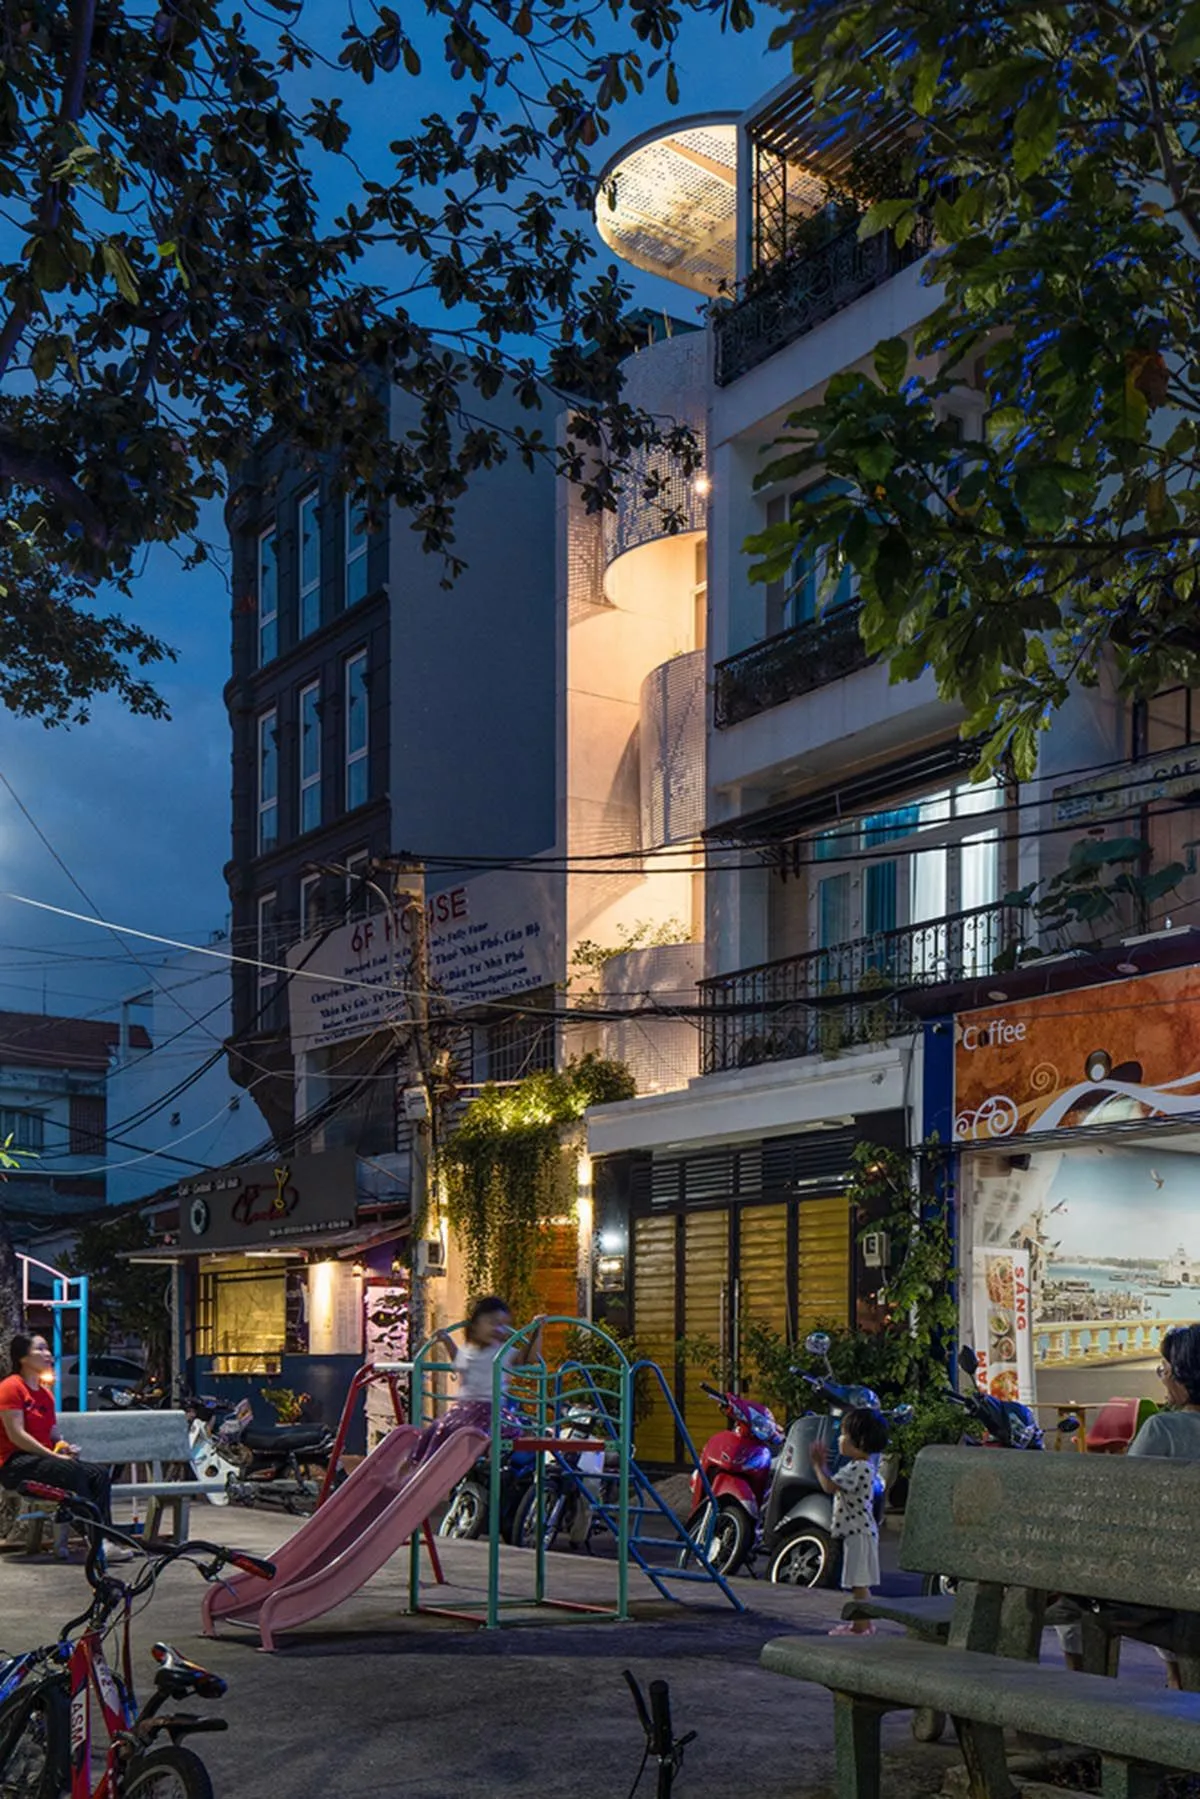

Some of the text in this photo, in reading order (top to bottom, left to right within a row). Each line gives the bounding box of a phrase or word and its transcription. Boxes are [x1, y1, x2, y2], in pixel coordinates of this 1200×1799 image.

[351, 922, 373, 952] 6F
[962, 1018, 1027, 1051] Coffee
[1015, 1266, 1031, 1331] SÁNG
